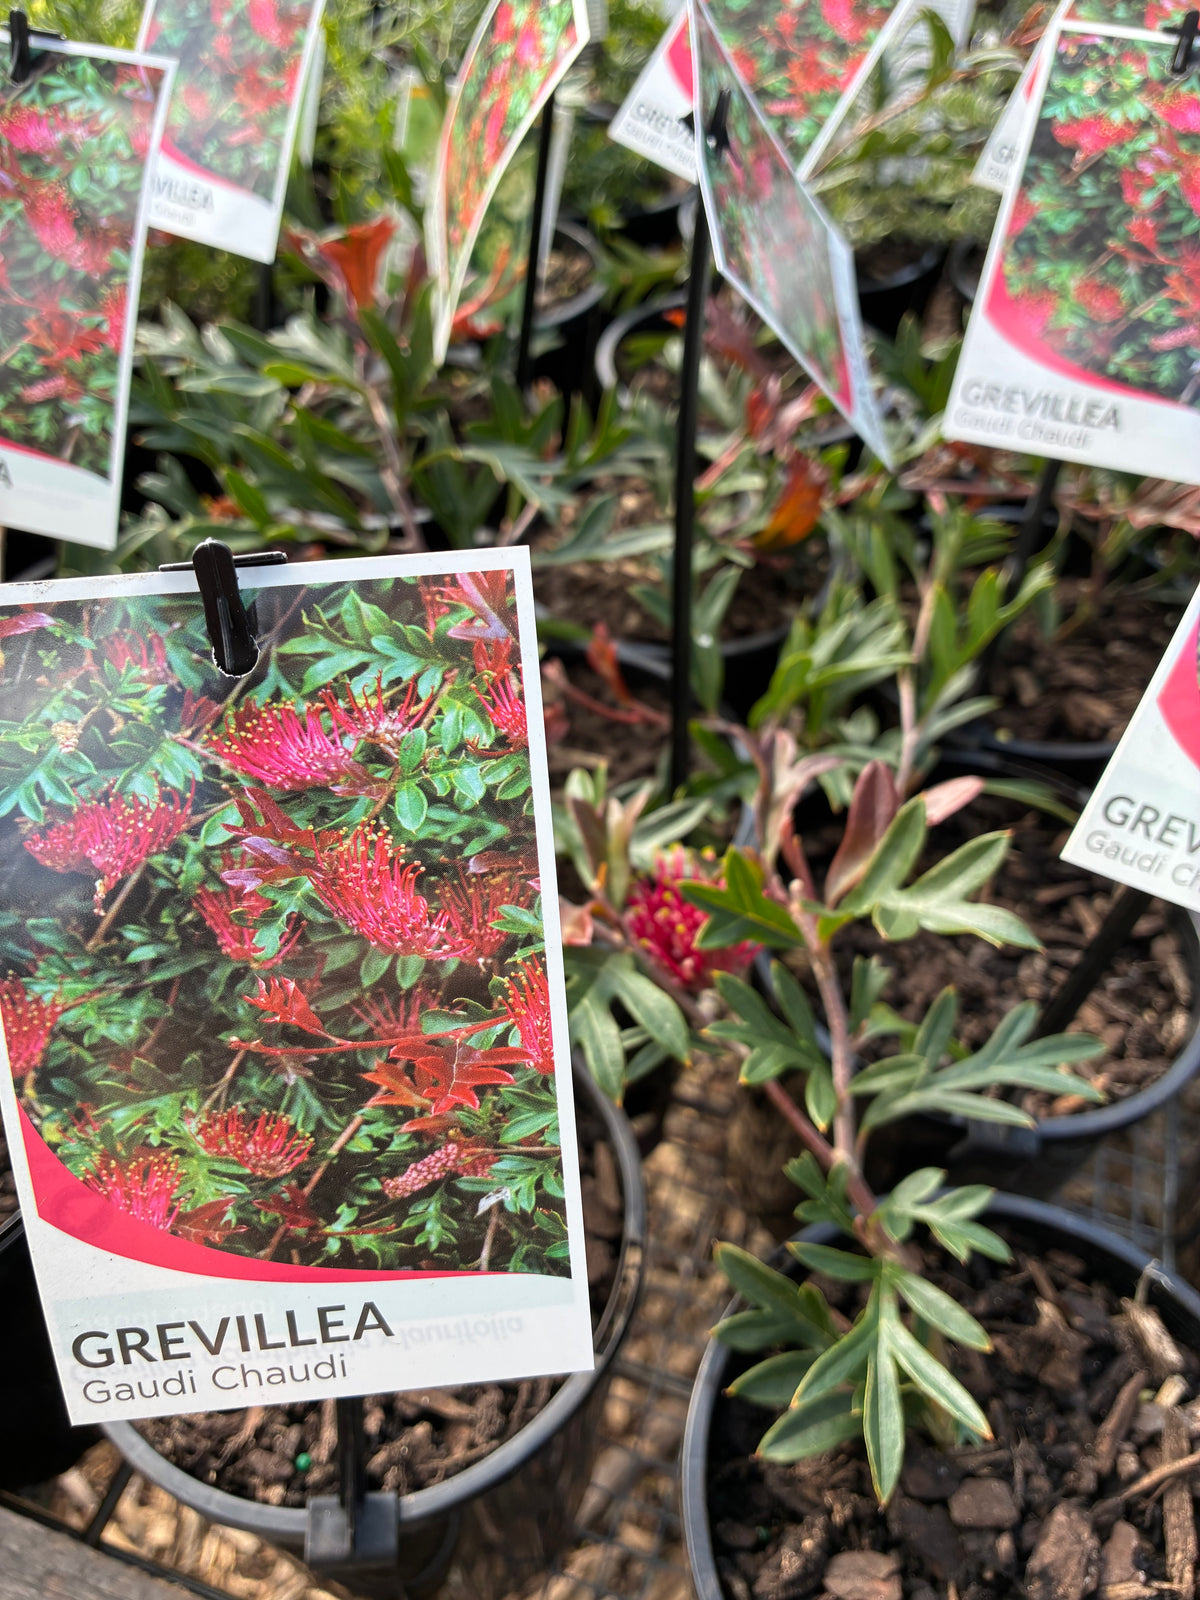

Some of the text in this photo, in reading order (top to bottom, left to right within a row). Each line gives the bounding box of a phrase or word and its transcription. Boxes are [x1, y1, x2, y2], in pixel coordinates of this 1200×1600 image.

[961, 379, 1121, 432] GREVILLEA
[1085, 829, 1168, 875] Gaudi
[71, 1302, 395, 1371] GREVILLEA
[82, 1377, 197, 1406] Gaudi
[211, 1354, 348, 1391] Chaudi
